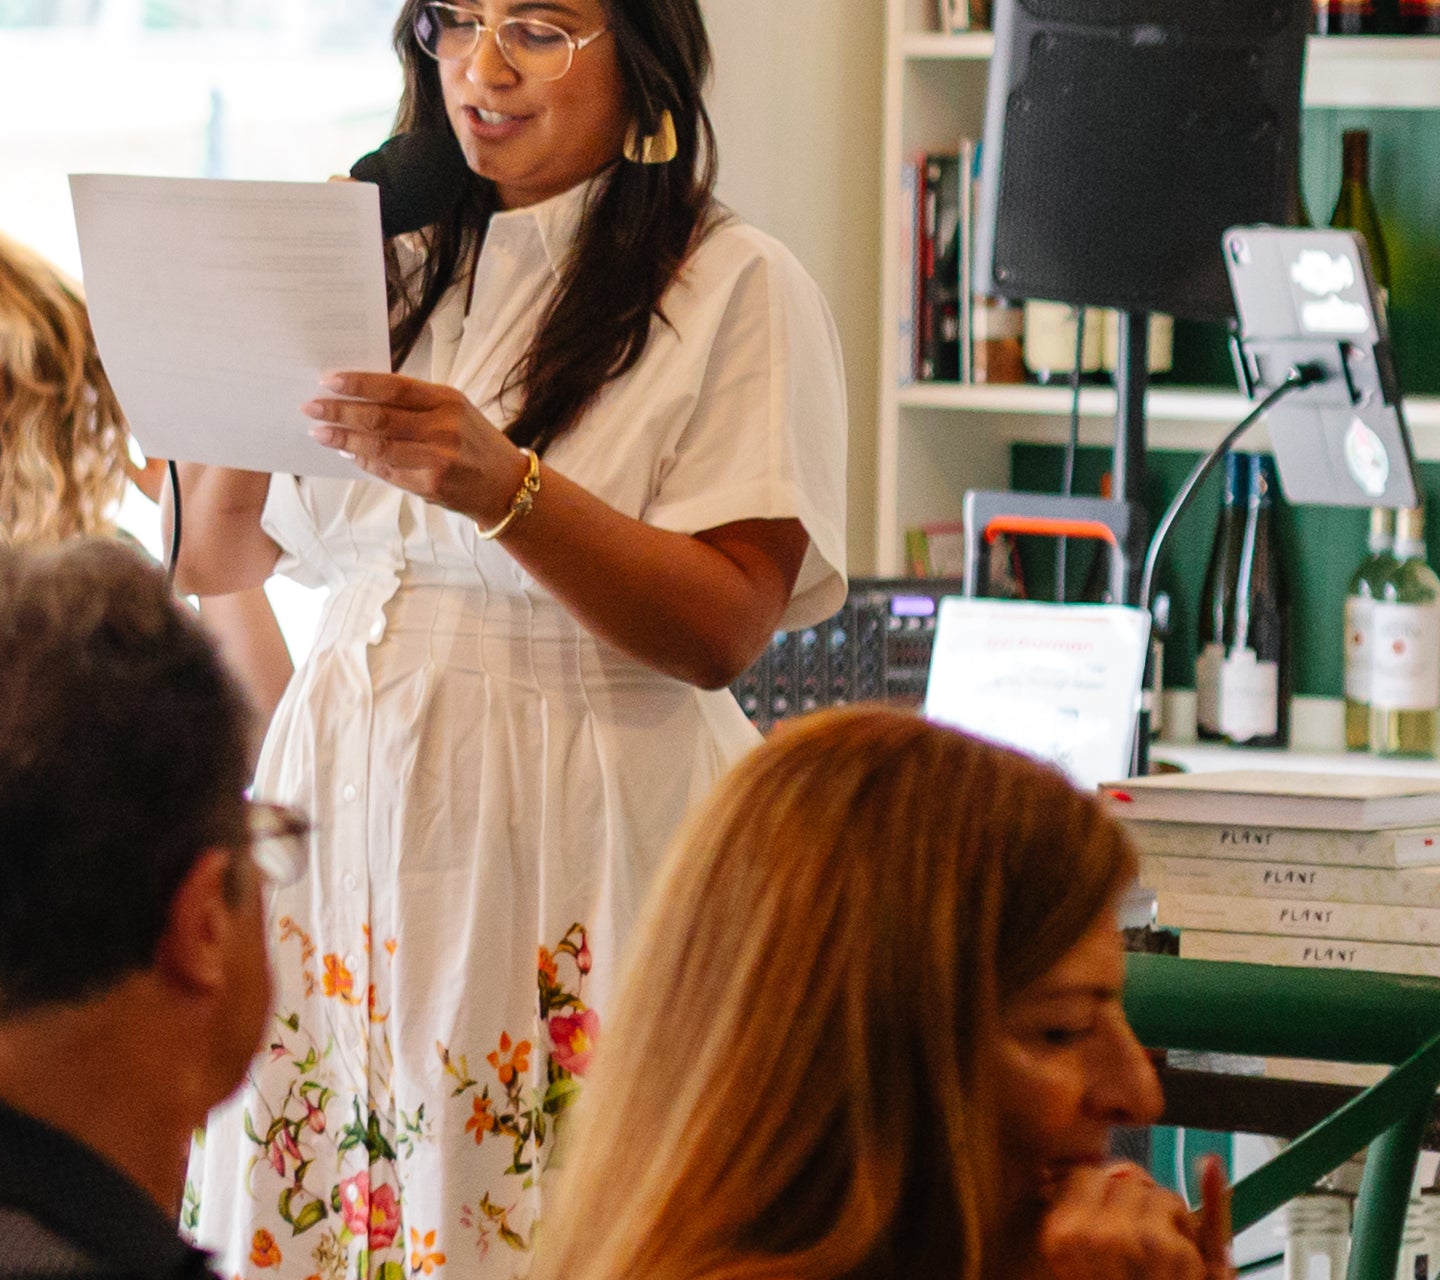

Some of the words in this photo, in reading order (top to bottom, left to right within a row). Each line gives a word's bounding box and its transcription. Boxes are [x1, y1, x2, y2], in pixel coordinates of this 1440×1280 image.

[1219, 829, 1275, 846] PLANT
[1262, 869, 1318, 886] PLANT
[1279, 907, 1334, 924] PLANT
[1302, 946, 1359, 964] PLANT
